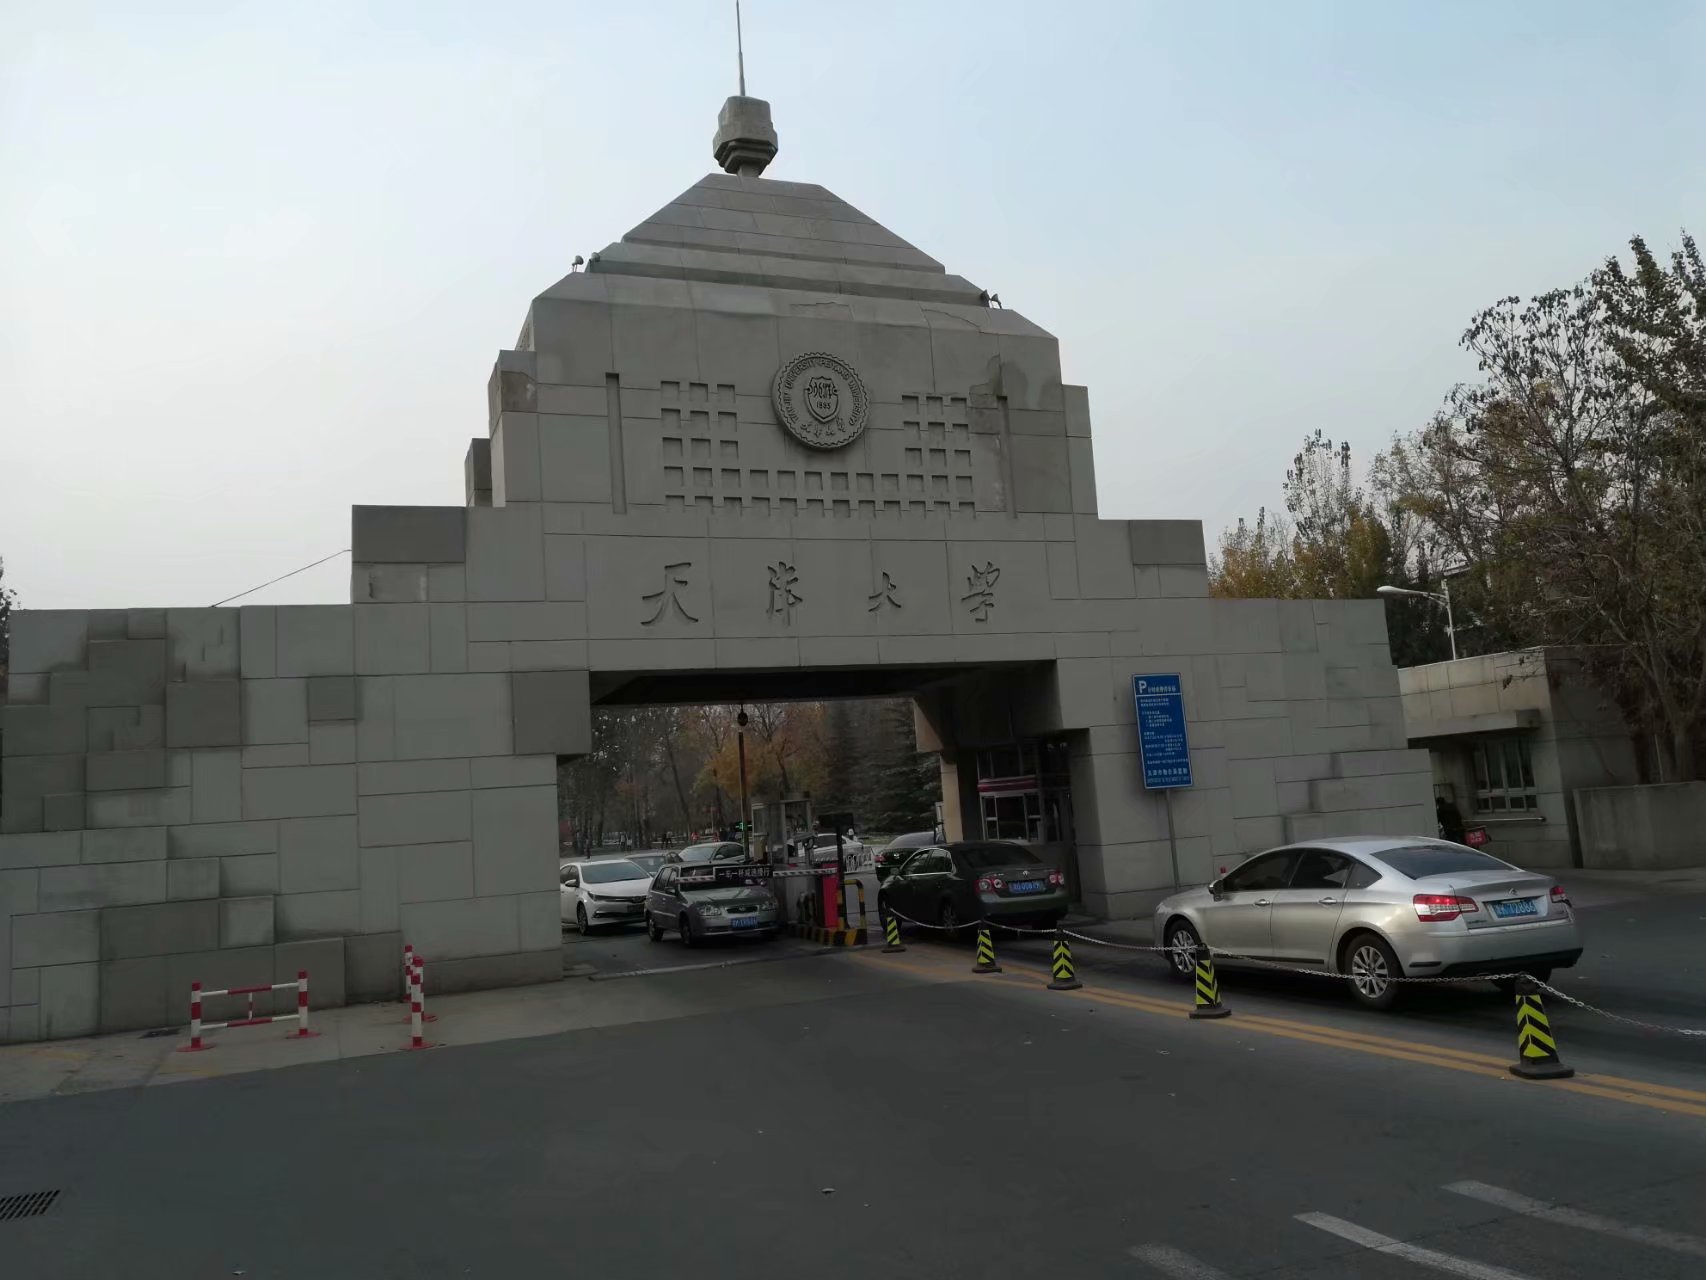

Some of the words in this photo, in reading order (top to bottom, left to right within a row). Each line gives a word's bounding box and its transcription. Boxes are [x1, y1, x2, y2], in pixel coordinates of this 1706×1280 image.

[640, 561, 1001, 627] 天津大学
[1138, 680, 1148, 694] P
